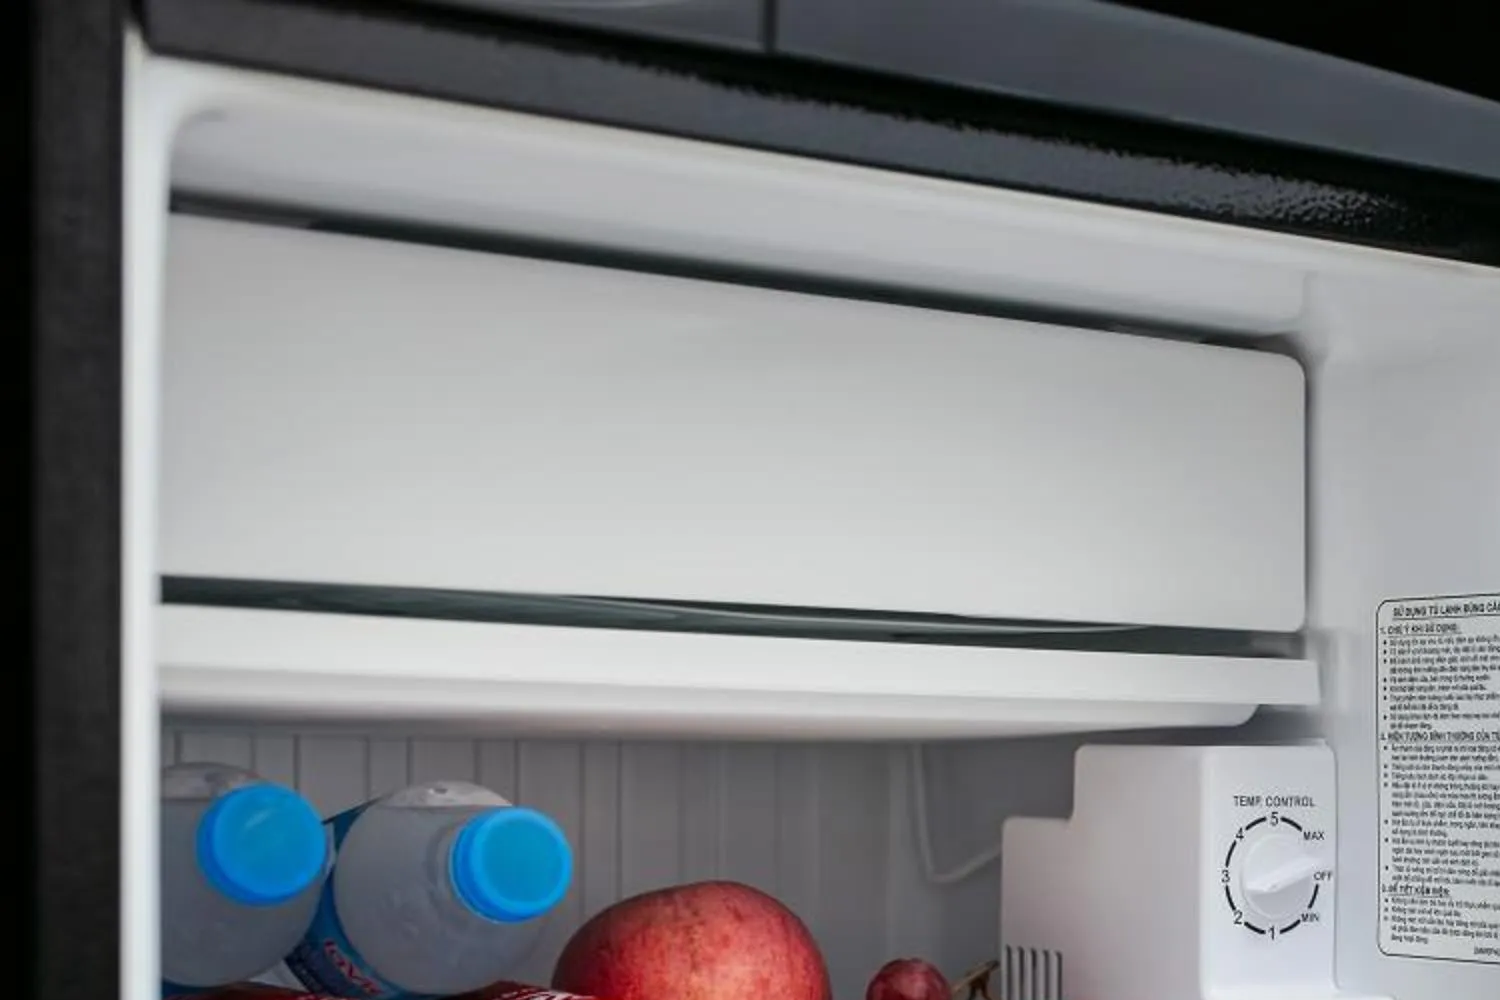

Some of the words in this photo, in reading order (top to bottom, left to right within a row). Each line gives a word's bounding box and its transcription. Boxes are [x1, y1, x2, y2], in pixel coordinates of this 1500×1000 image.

[1265, 795, 1316, 807] CONTROL
[1269, 811, 1279, 826] 5
[1235, 827, 1244, 842] 4
[1303, 831, 1325, 841] MAX
[1221, 869, 1231, 884] 3
[1313, 871, 1333, 881] OFF
[1233, 910, 1243, 925] 2
[1301, 912, 1319, 922] MIN
[1268, 925, 1275, 940] 1
